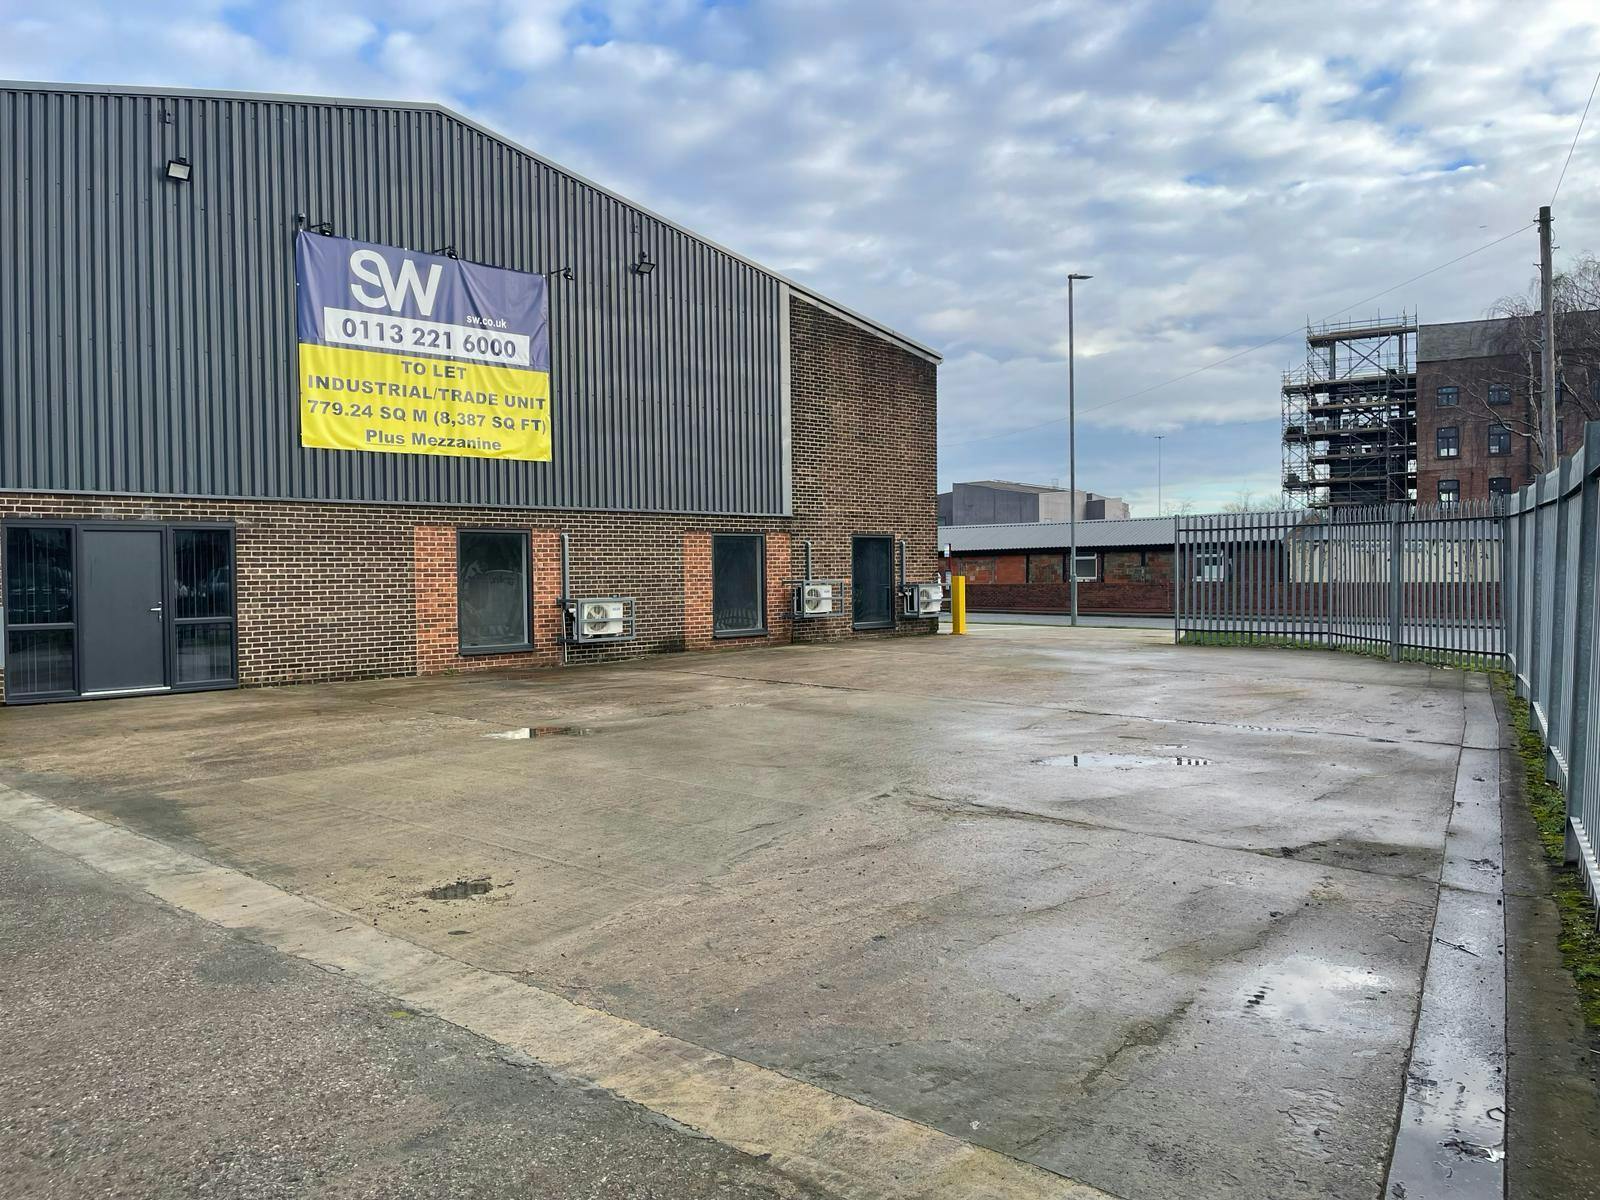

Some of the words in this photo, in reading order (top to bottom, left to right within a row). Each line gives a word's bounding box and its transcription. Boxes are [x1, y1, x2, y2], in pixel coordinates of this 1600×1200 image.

[350, 250, 443, 316] SW
[342, 318, 403, 344] 0113
[412, 327, 451, 350] 221
[462, 334, 516, 358] 6000
[466, 314, 507, 329] sw.co.uk
[401, 360, 426, 376] TO
[433, 364, 467, 380] LET
[308, 375, 498, 406] INDUSTRIAL/TRADE
[504, 395, 546, 410] UNIT
[307, 400, 373, 418] 779.24
[380, 407, 406, 422] SQ
[413, 409, 427, 423] M
[433, 409, 486, 428] (8,387
[492, 416, 515, 430] SQ
[521, 419, 546, 434] FT)
[366, 429, 405, 445] Plus
[412, 432, 501, 451] Mezzanine
